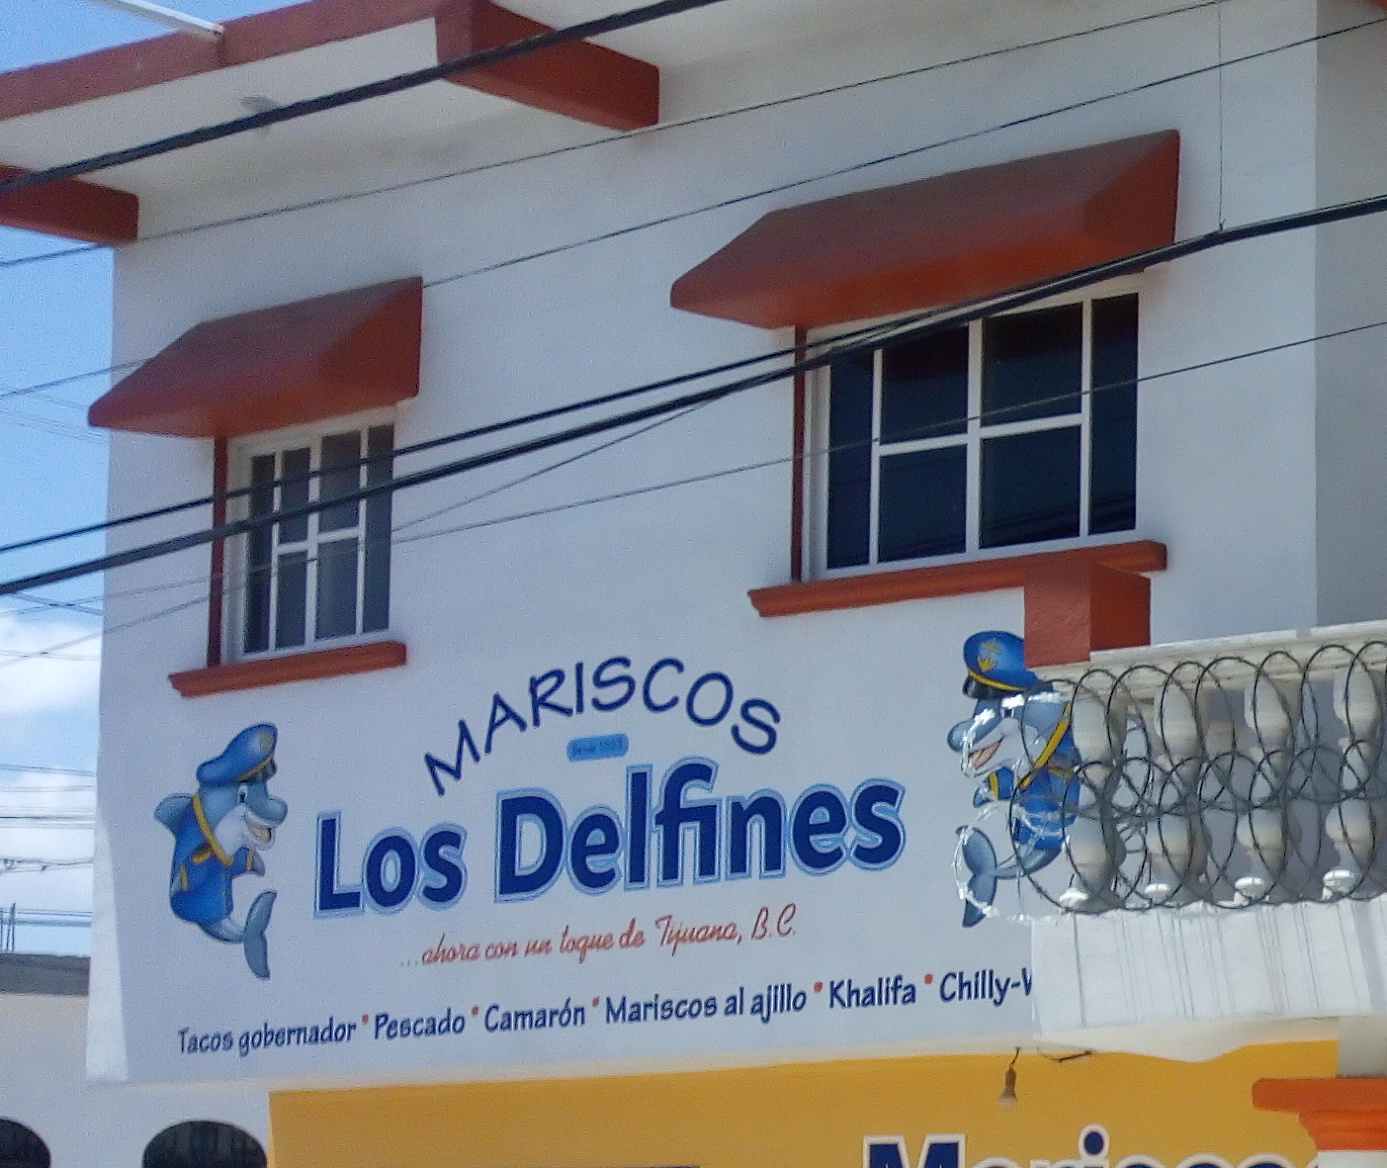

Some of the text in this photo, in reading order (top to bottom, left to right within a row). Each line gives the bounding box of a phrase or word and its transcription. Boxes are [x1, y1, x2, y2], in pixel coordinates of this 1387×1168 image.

[424, 656, 781, 796] MARISCOS
[315, 757, 905, 917] Los Delfines
[485, 941, 519, 960] con
[524, 939, 552, 957] un
[560, 925, 614, 964] toque
[619, 917, 645, 948] de
[655, 914, 743, 956] Tijuana,
[178, 1027, 233, 1055] Tacos
[238, 1016, 357, 1057] gobernador
[374, 1008, 465, 1040] Pescado
[484, 997, 585, 1032] Camarón
[605, 993, 717, 1024] Mariscos
[724, 987, 744, 1016] al
[750, 984, 806, 1024] ajillo
[829, 974, 916, 1009] Khalifa
